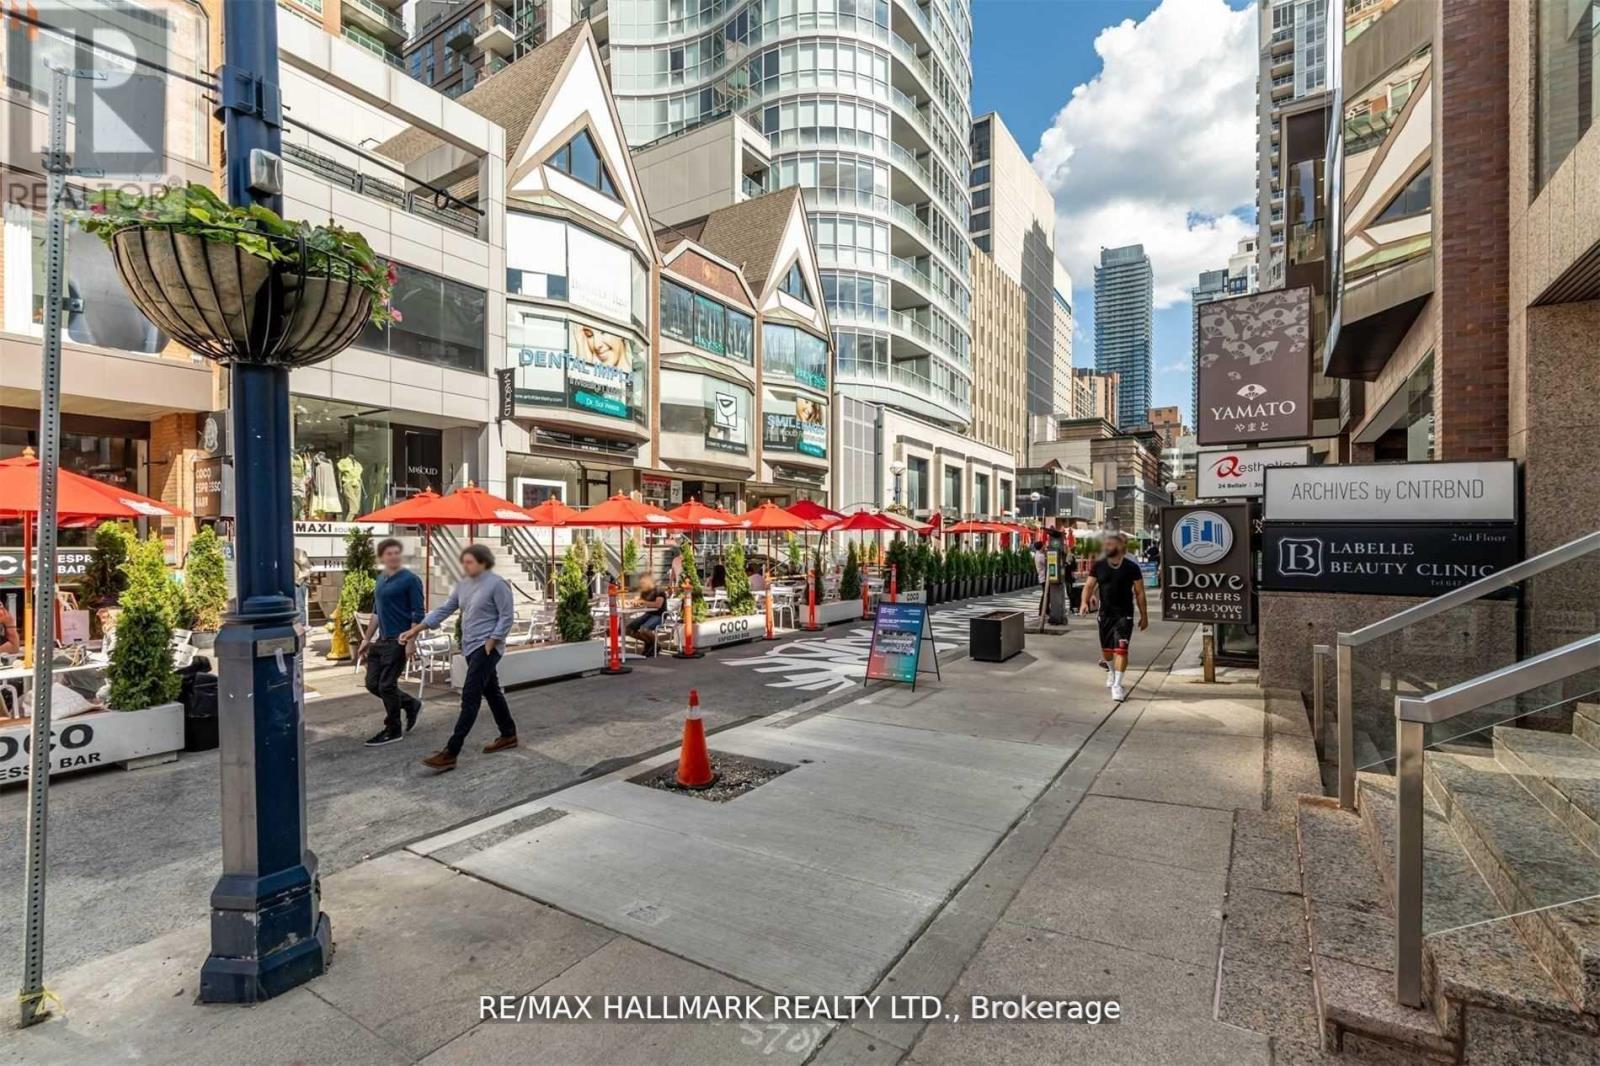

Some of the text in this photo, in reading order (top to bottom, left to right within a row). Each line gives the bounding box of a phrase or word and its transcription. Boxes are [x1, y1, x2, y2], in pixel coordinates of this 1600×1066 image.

[518, 348, 590, 375] DENTAL
[1210, 400, 1297, 421] YAMATO
[1234, 421, 1269, 432] やまと
[1291, 479, 1484, 503] ARCHIVES by CNTRBND
[295, 523, 332, 533] MAXI
[1451, 533, 1507, 542] 2nd Floor
[1330, 542, 1415, 555] LABELLE
[1330, 561, 1495, 578] BEAUTY CLINIC
[1169, 565, 1244, 591] Dove
[1170, 591, 1241, 602] CLEANERS
[720, 619, 748, 634] COCO
[60, 752, 102, 769] BAR
